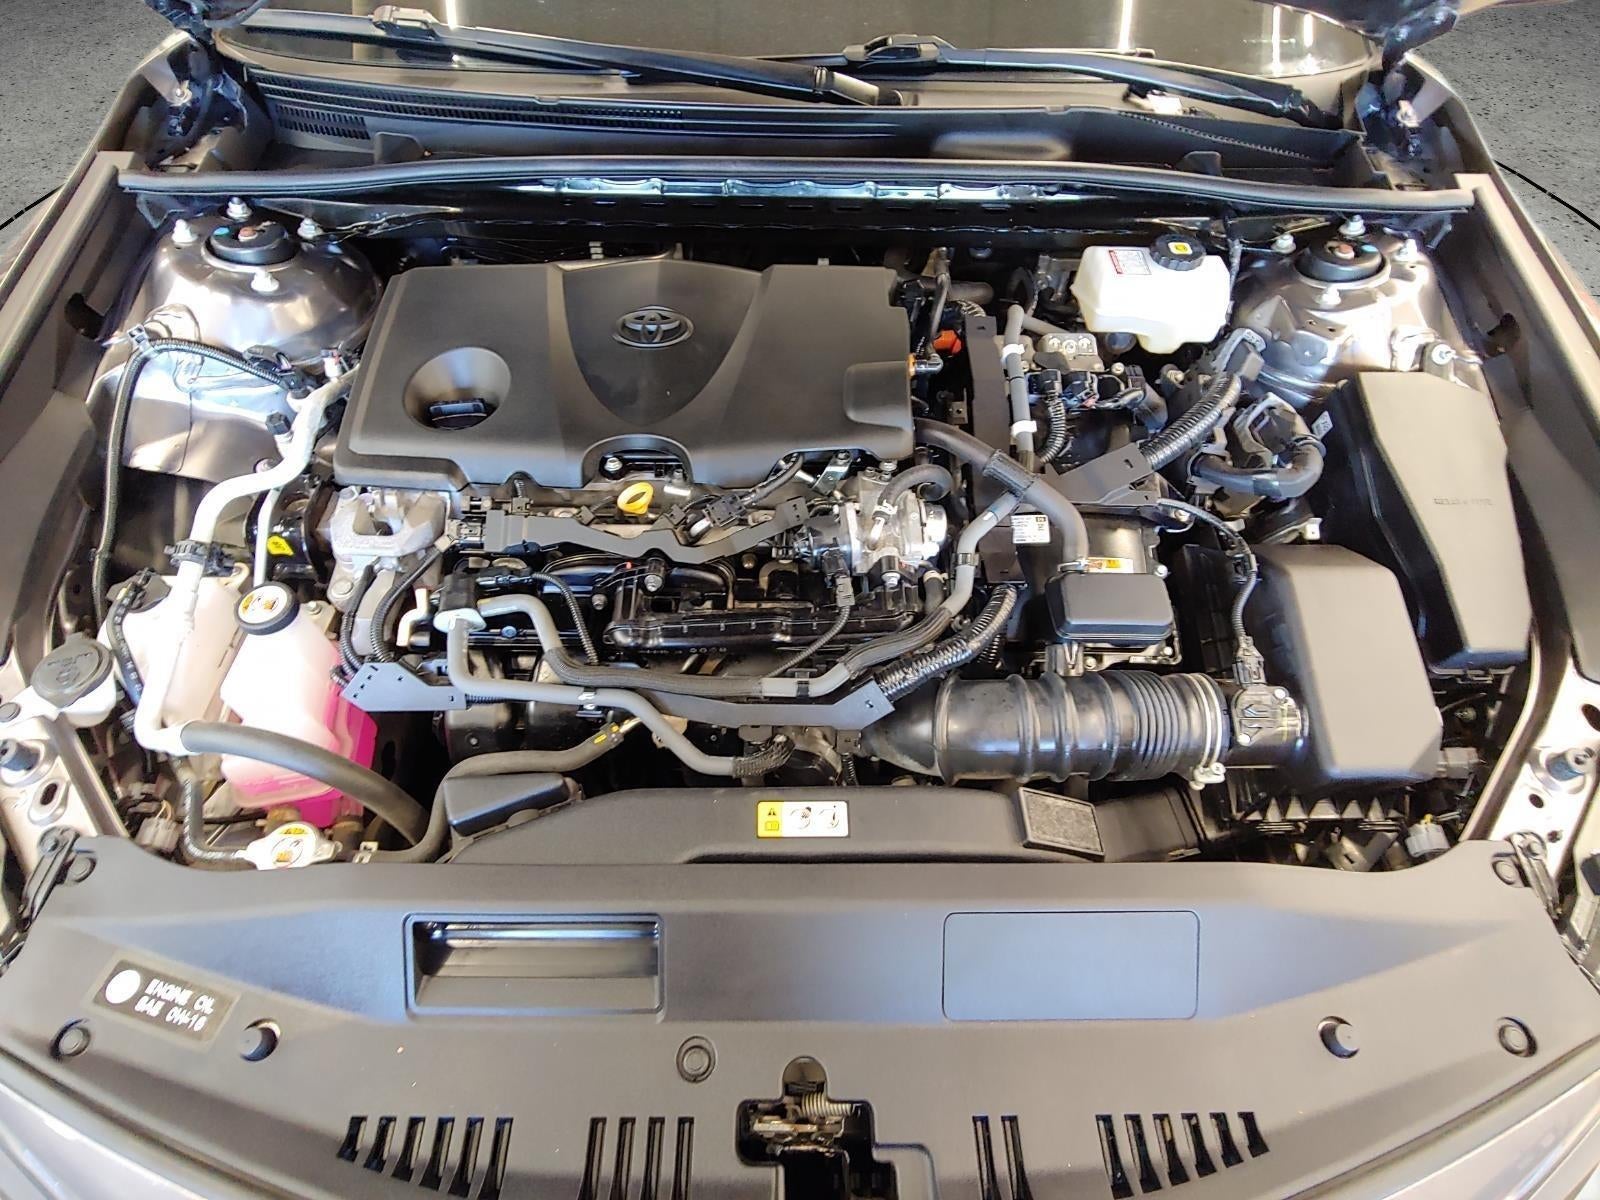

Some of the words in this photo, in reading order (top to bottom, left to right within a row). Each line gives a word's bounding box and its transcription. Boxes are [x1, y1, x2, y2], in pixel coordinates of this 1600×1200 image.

[134, 995, 166, 1017] SAE
[144, 978, 194, 1006] ENGINE
[193, 994, 215, 1015] OIL
